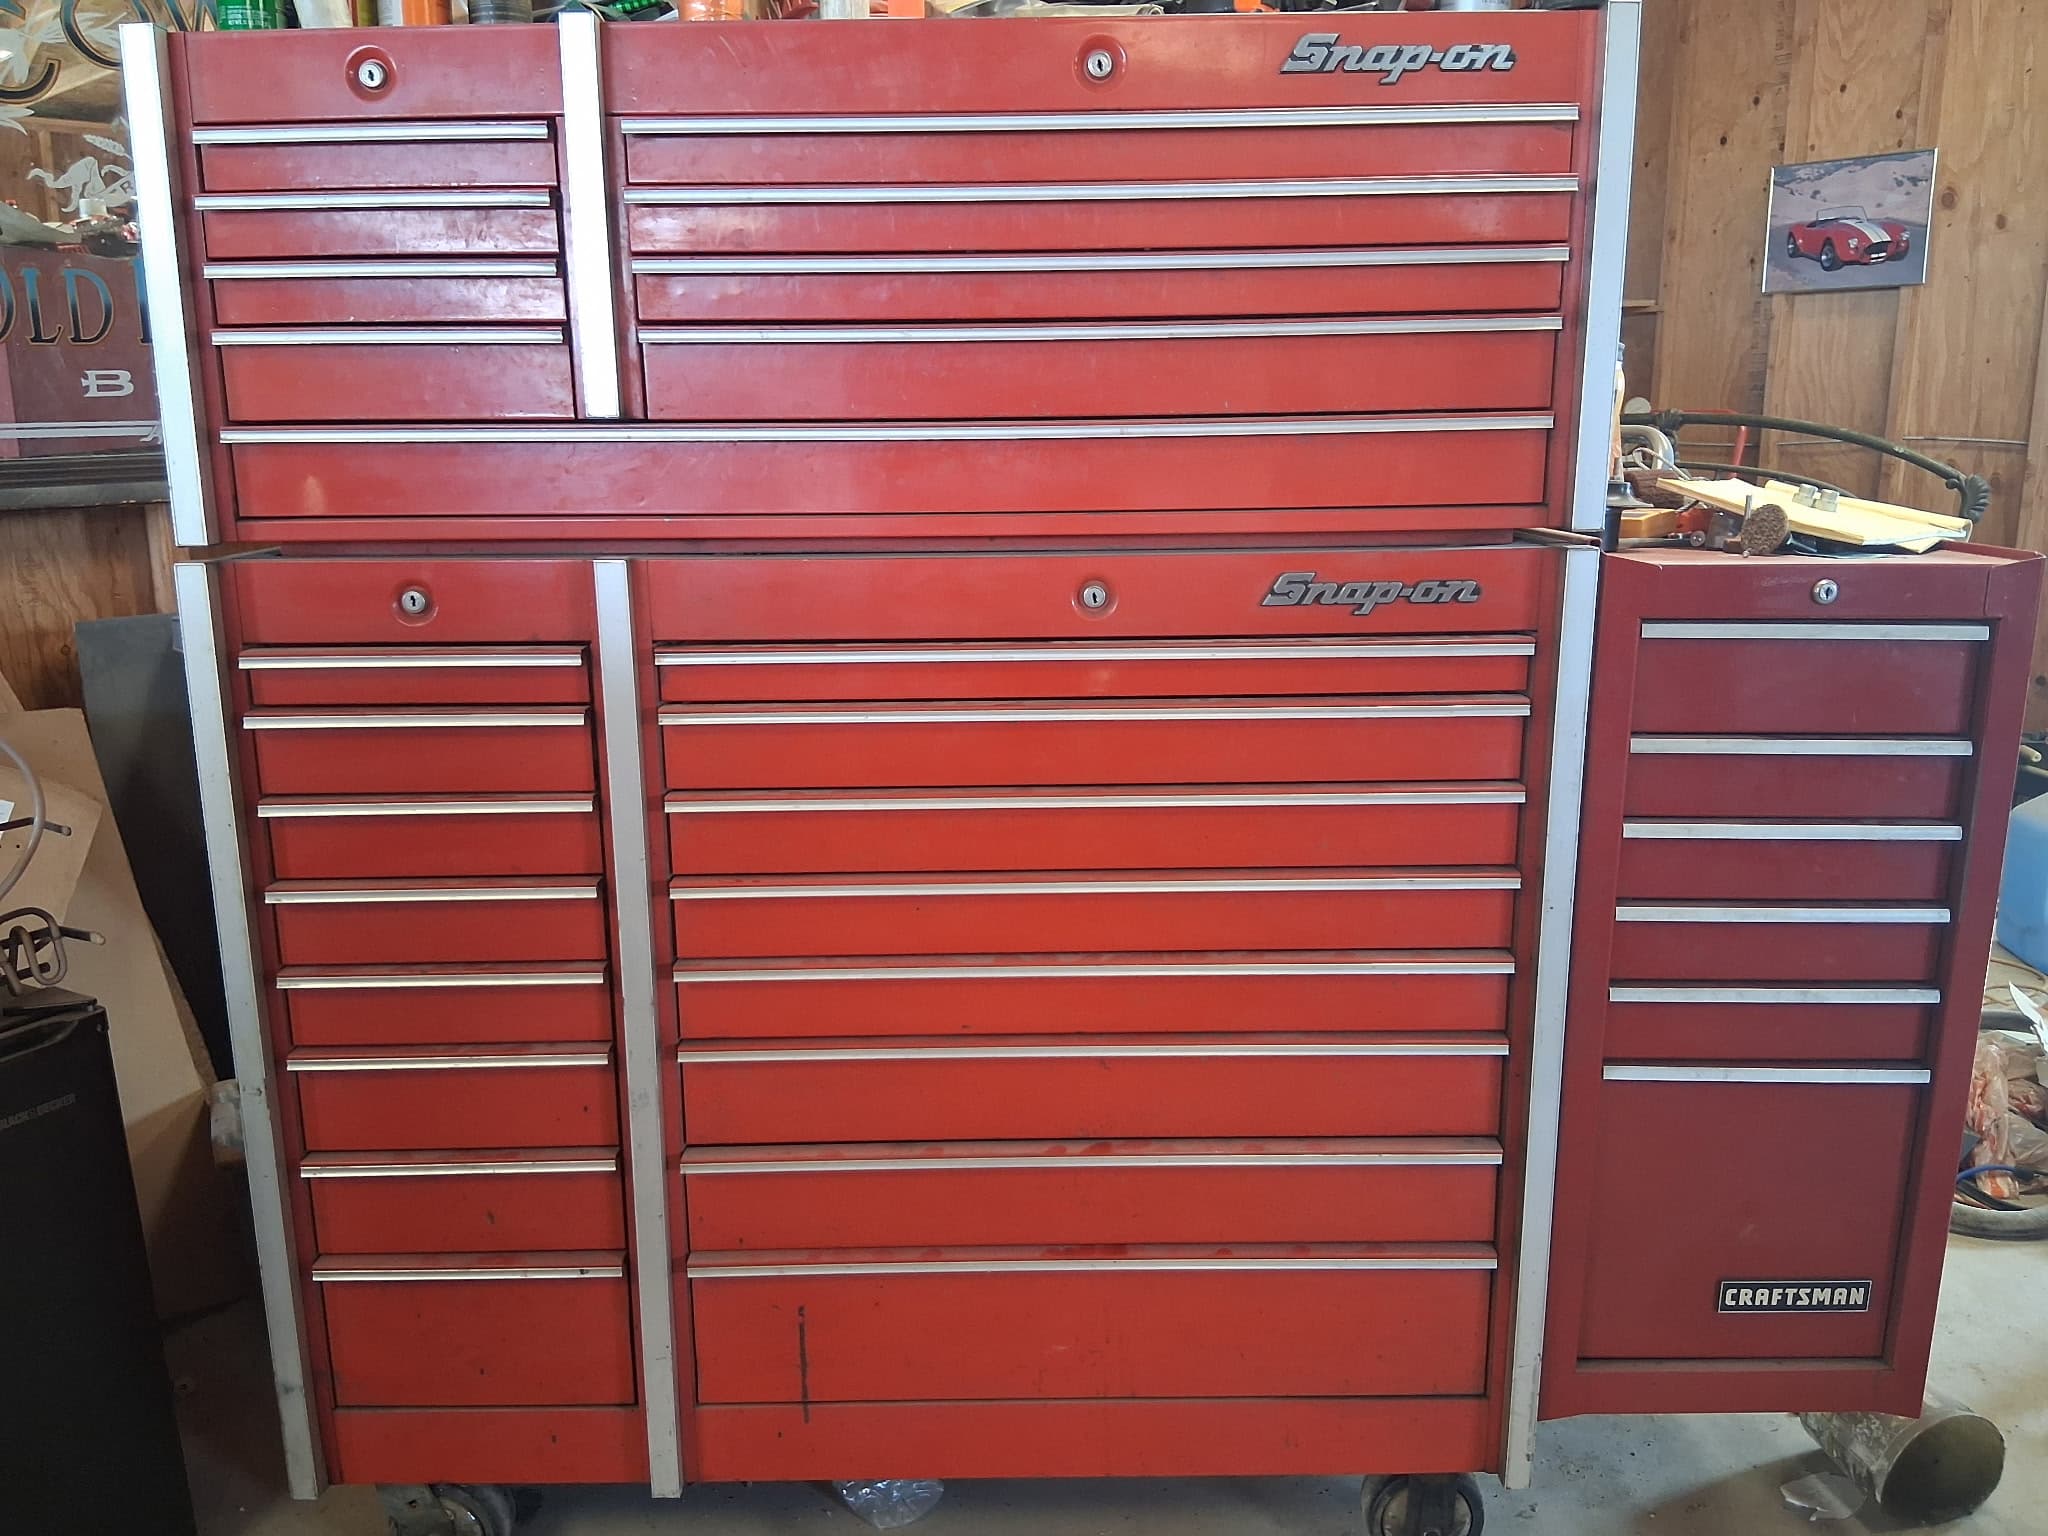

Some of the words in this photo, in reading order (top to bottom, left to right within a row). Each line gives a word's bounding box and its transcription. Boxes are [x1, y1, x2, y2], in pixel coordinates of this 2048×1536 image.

[1280, 33, 1516, 85] Snap-on
[1260, 571, 1482, 616] Snap-on
[1725, 1287, 1865, 1306] CRAFTSMAN
